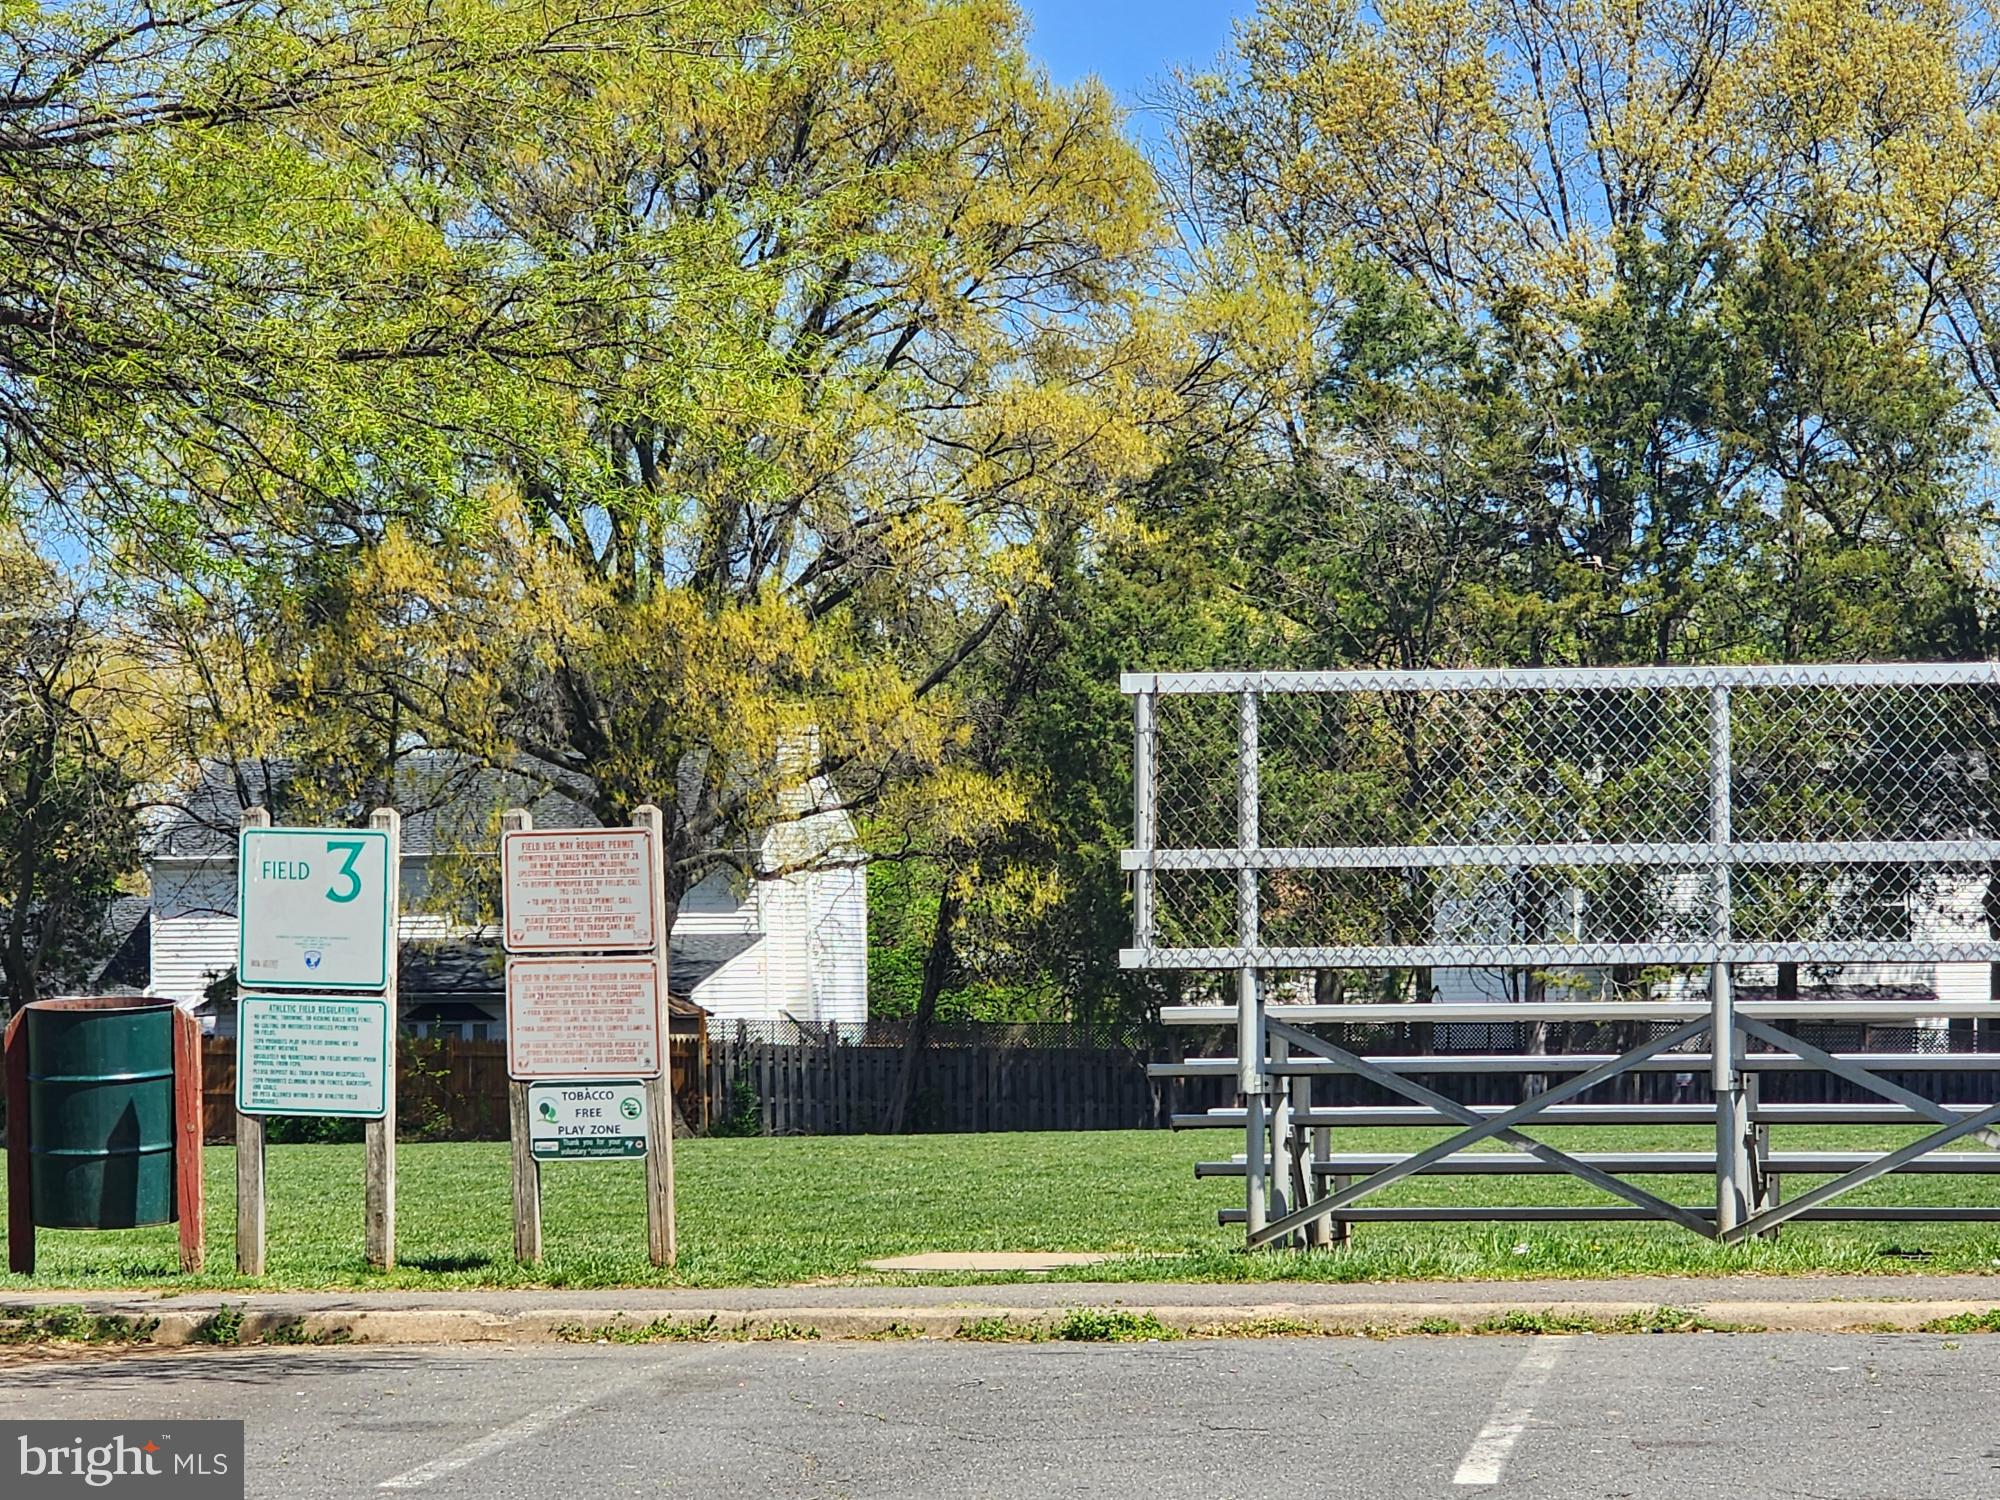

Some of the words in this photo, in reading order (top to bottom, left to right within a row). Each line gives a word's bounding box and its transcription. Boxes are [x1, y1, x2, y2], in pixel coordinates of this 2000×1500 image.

[522, 842, 540, 850] FIELD
[544, 842, 555, 850] USE
[576, 841, 604, 850] REQUIRE
[609, 840, 634, 848] PERMIT
[263, 861, 310, 880] FIELD
[325, 841, 366, 903] 3
[269, 1004, 296, 1012] ATHLETIC
[299, 1005, 315, 1013] FIELD
[319, 1006, 359, 1014] REGULATIONS
[562, 1091, 614, 1100] TOBACCO
[576, 1108, 602, 1117] FREE
[558, 1126, 585, 1135] PLAY
[591, 1125, 621, 1134] ZONE
